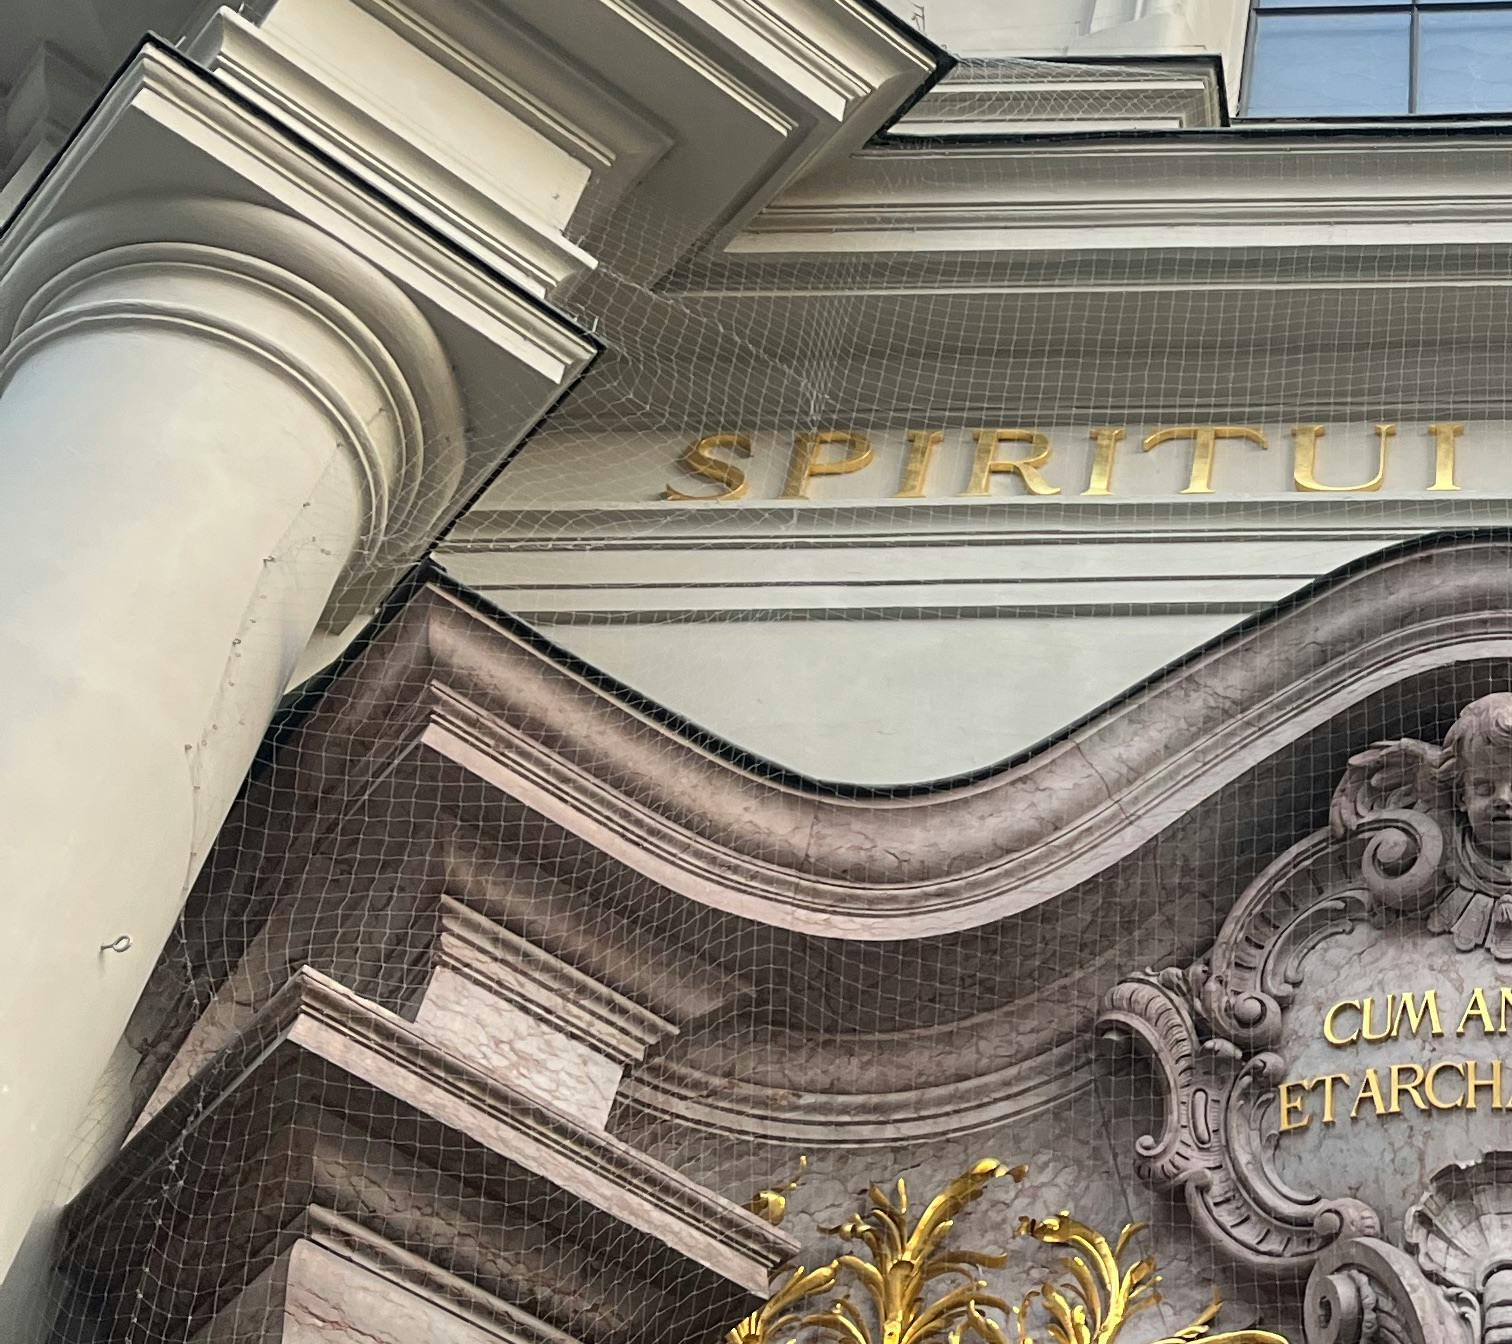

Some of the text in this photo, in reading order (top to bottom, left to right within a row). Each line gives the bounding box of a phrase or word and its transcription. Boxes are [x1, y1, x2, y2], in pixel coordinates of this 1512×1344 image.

[660, 423, 1464, 501] SPIRITUI
[1323, 988, 1443, 1045] CUM
[1278, 1072, 1351, 1133] ET
